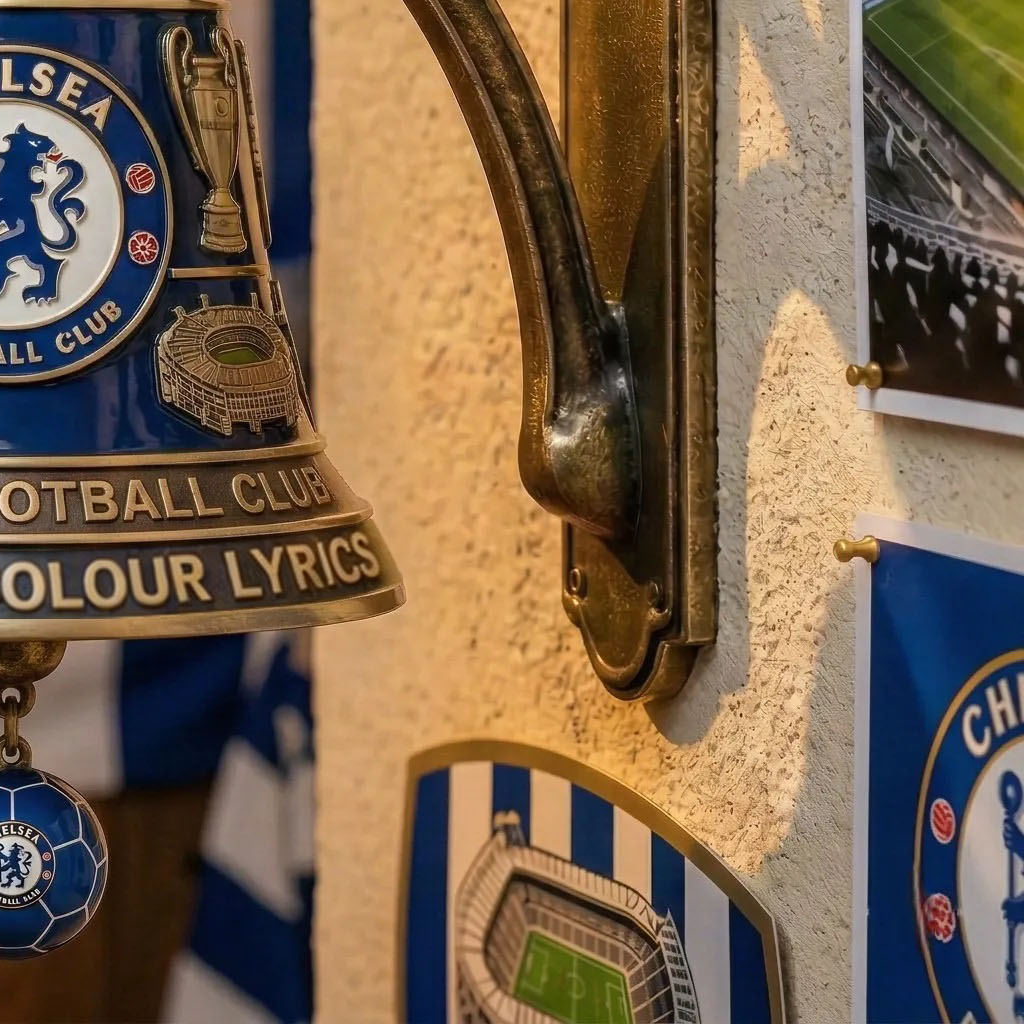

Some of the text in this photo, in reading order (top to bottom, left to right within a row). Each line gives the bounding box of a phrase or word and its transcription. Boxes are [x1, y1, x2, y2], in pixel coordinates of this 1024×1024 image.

[55, 300, 123, 355] CLUB
[232, 463, 330, 515] CLUB
[222, 529, 382, 600] LYRICS
